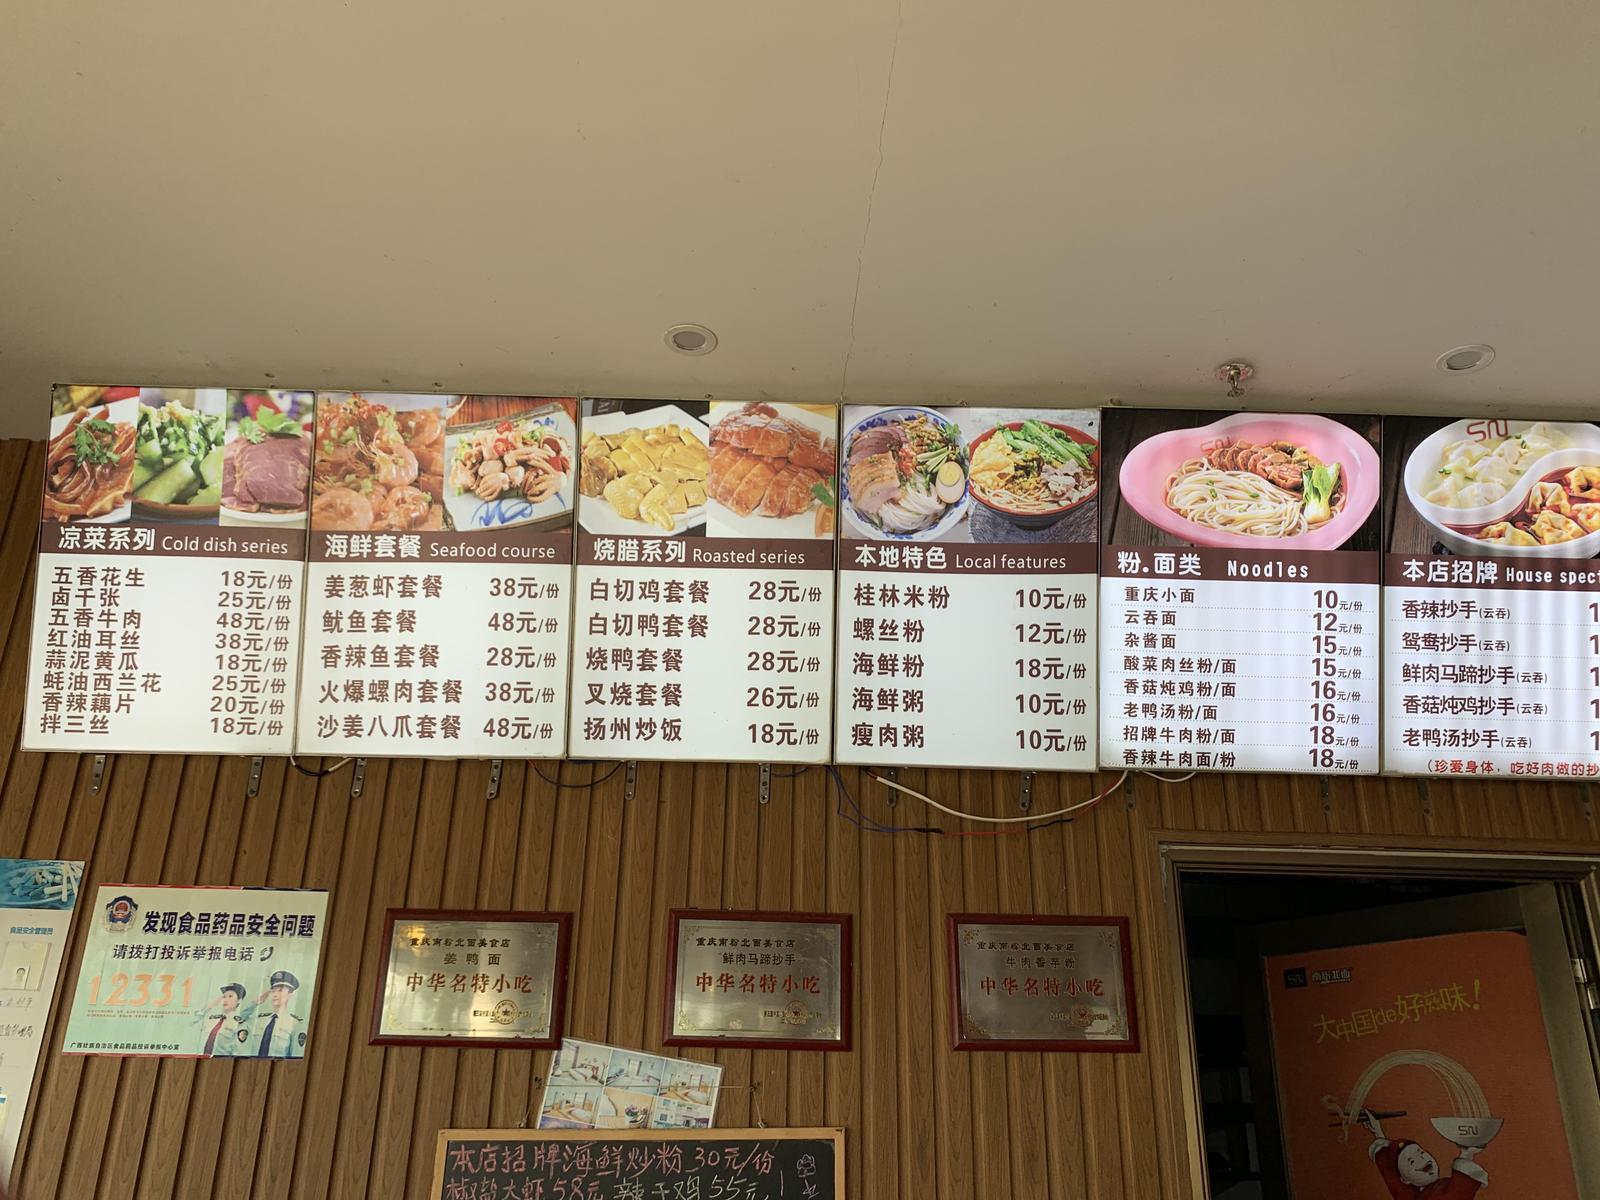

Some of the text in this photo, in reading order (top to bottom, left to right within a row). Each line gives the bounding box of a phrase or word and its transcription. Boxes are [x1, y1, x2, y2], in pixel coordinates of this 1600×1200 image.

[59, 526, 287, 553] 凉菜系列 Cold dish series
[326, 535, 555, 558] 海鲜套餐 Seafood course
[594, 538, 804, 563] 烧腊系列 Roasted series
[855, 544, 1065, 569] 本地特色 Local features
[1118, 552, 1308, 577] 粉.面类 Noodles
[52, 567, 292, 589] 五香花生 18元/份
[1403, 559, 1497, 583] 本店招牌
[1507, 568, 1552, 582] House
[324, 575, 559, 598] 姜葱虾套餐 38元/份
[591, 578, 821, 603] 白切鸡套餐 28元/份
[854, 583, 1087, 609] 桂林米粉 10元/份
[52, 588, 291, 610] 卤千张 25元/份
[1125, 587, 1362, 610] 重庆小面 10元/份
[1402, 600, 1510, 619] 香辣抄手(云吞)
[49, 608, 290, 630] 五香牛肉 48元/份
[323, 609, 558, 633] 鱿鱼套餐 48元/份
[589, 613, 821, 637] 白切鸭套餐 28元/份
[1125, 610, 1362, 633] 云吞面 12元/份
[47, 629, 288, 651] 红油耳丝 38元/份
[853, 618, 1086, 644] 螺丝粉 12元/份
[1402, 632, 1509, 652] 鸳鸯抄手(云吞)
[321, 644, 556, 668] 香辣鱼套餐 28元/份
[1125, 633, 1362, 656] 杂酱面 15元/份
[45, 650, 287, 672] 蒜泥黄瓜 18元/份
[586, 647, 820, 673] 烧鸭套餐 28元/份
[853, 652, 1086, 679] 海鲜粉 18元/份
[1124, 656, 1361, 679] 酸菜肉丝粉/面 15元/份
[44, 673, 286, 693] 蚝油西兰花 25元/份
[1403, 663, 1547, 684] 鲜肉马蹄抄手(云吞)
[319, 679, 555, 703] 火爆螺肉套餐 38元/份
[585, 682, 819, 709] 叉烧套餐 26元/份
[852, 687, 1086, 715] 海鲜粥 10元/份
[1124, 679, 1360, 701] 香菇炖鸡粉/面 16元/份
[42, 693, 285, 714] 香辣藕片 20元/份
[1124, 703, 1360, 724] 老鸭汤粉/面 16元/份
[1403, 695, 1547, 716] 香菇炖鸡抄手(云吞)
[41, 714, 283, 735] 拌三丝 18元/份
[317, 715, 553, 739] 沙姜八爪套餐 48元/份
[584, 717, 819, 745] 扬州炒饭 18元/份
[1123, 725, 1359, 746] 招牌牛肉粉/面 18元/份
[852, 722, 1087, 751] 瘦肉粥 10元/份
[1403, 728, 1531, 748] 老鸭汤抄手(云吞)
[1123, 749, 1358, 770] 香辣牛肉面/粉 18元/份
[143, 911, 315, 937] 发现食品药品安全问题
[113, 944, 254, 961] 请拨打投诉举报电话
[444, 953, 502, 965] 姜鸭面
[722, 953, 795, 966] 鲜肉马蹄抄手
[87, 972, 193, 1008] 12331
[406, 973, 533, 993] 中华名特小吃
[696, 973, 820, 994] 中华名特小吃
[980, 977, 1104, 997] 中华名特小吃
[450, 1141, 774, 1176] 本店招牌海鲜炒粉 30元/份
[553, 1177, 603, 1200] 58元
